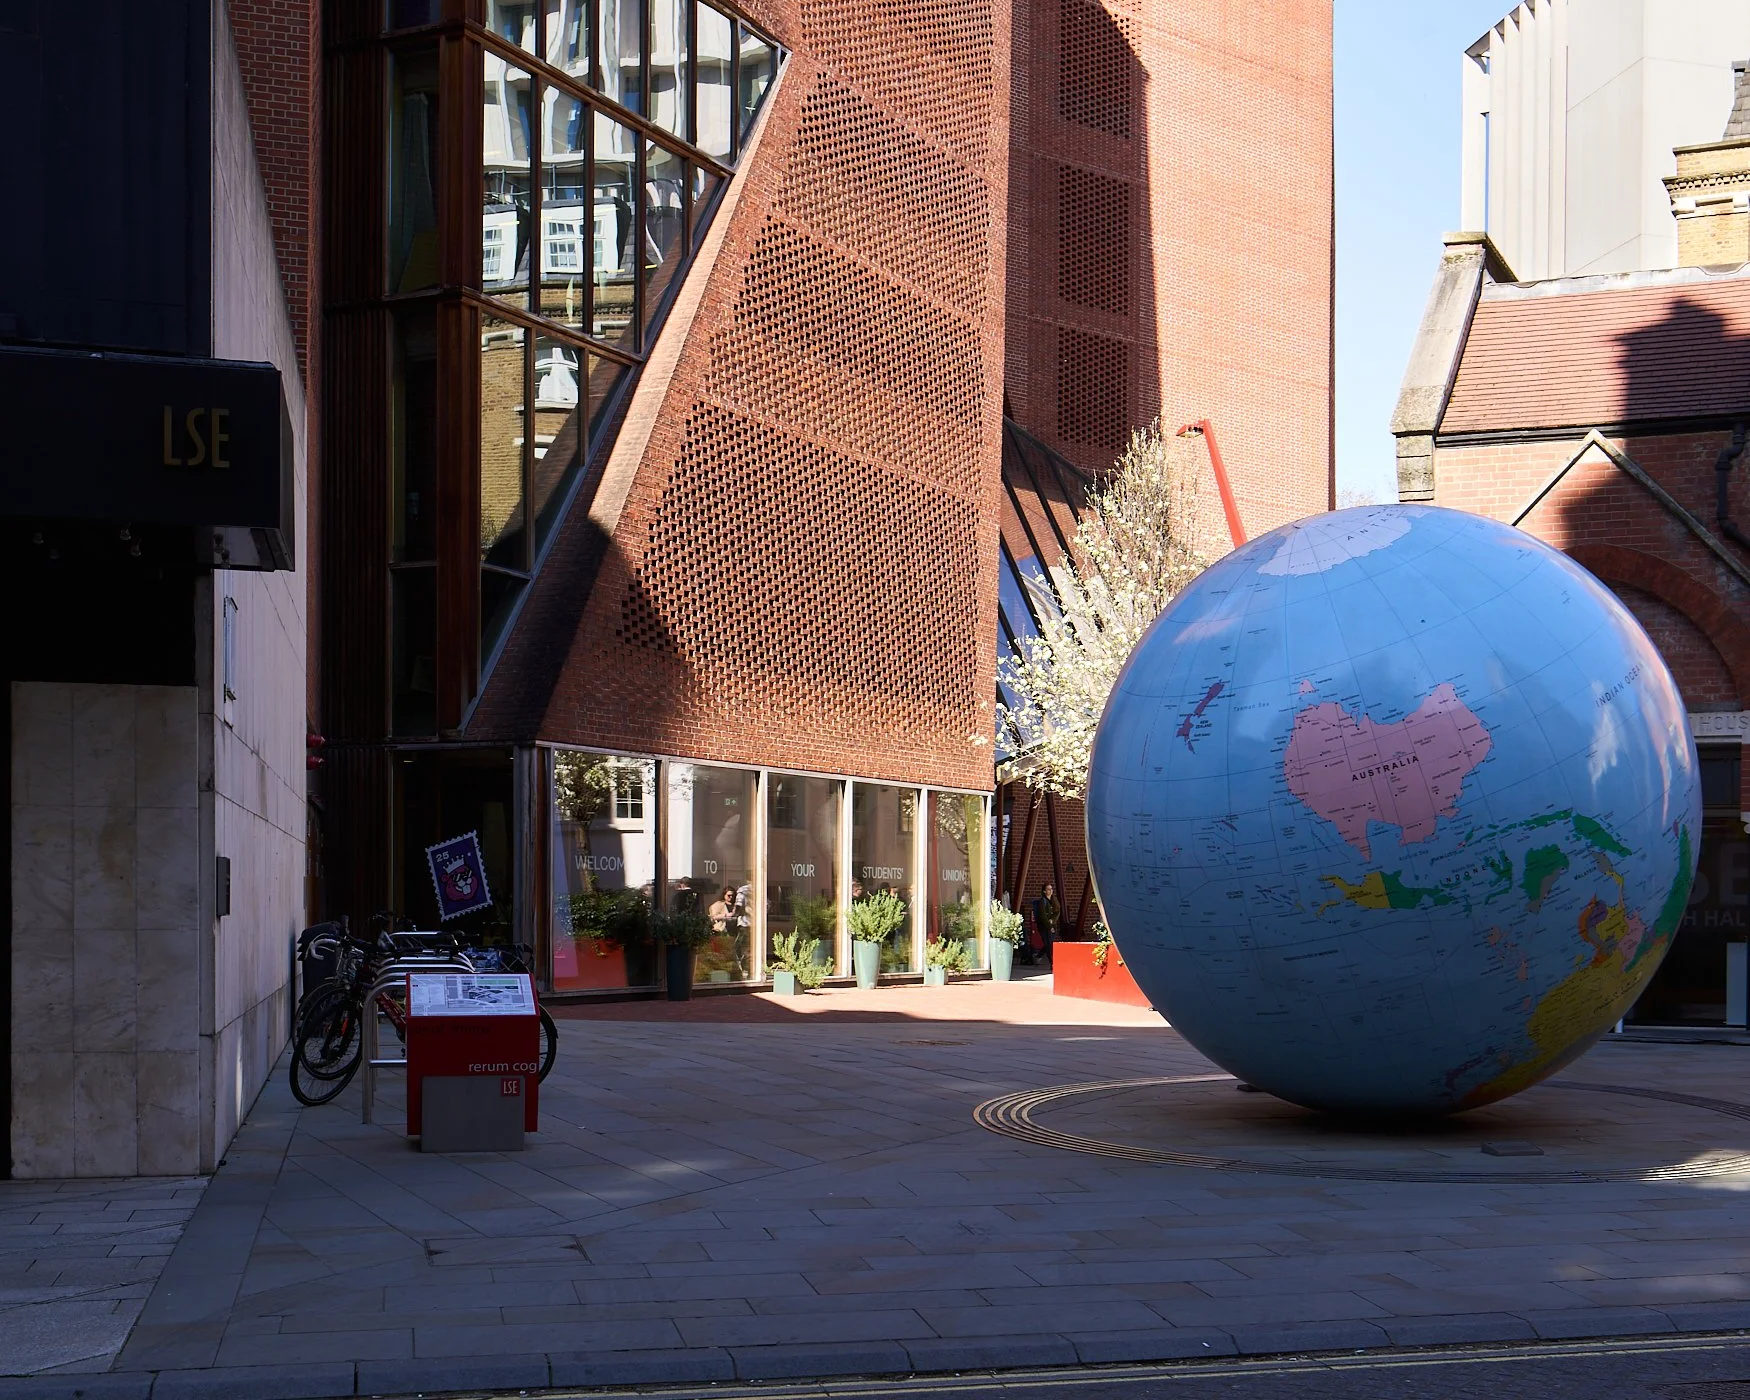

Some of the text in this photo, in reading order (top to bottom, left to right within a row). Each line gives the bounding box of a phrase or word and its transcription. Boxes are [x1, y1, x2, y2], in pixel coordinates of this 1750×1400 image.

[163, 404, 230, 468] LSE
[1595, 681, 1624, 708] INDIAN
[1352, 756, 1419, 782] AUSTRALIA
[436, 851, 450, 863] 25
[575, 855, 966, 881] WELCOM TO YOUR STUDENTS' UNION
[469, 1062, 538, 1074] rerum cog
[503, 1080, 518, 1094] LSE
